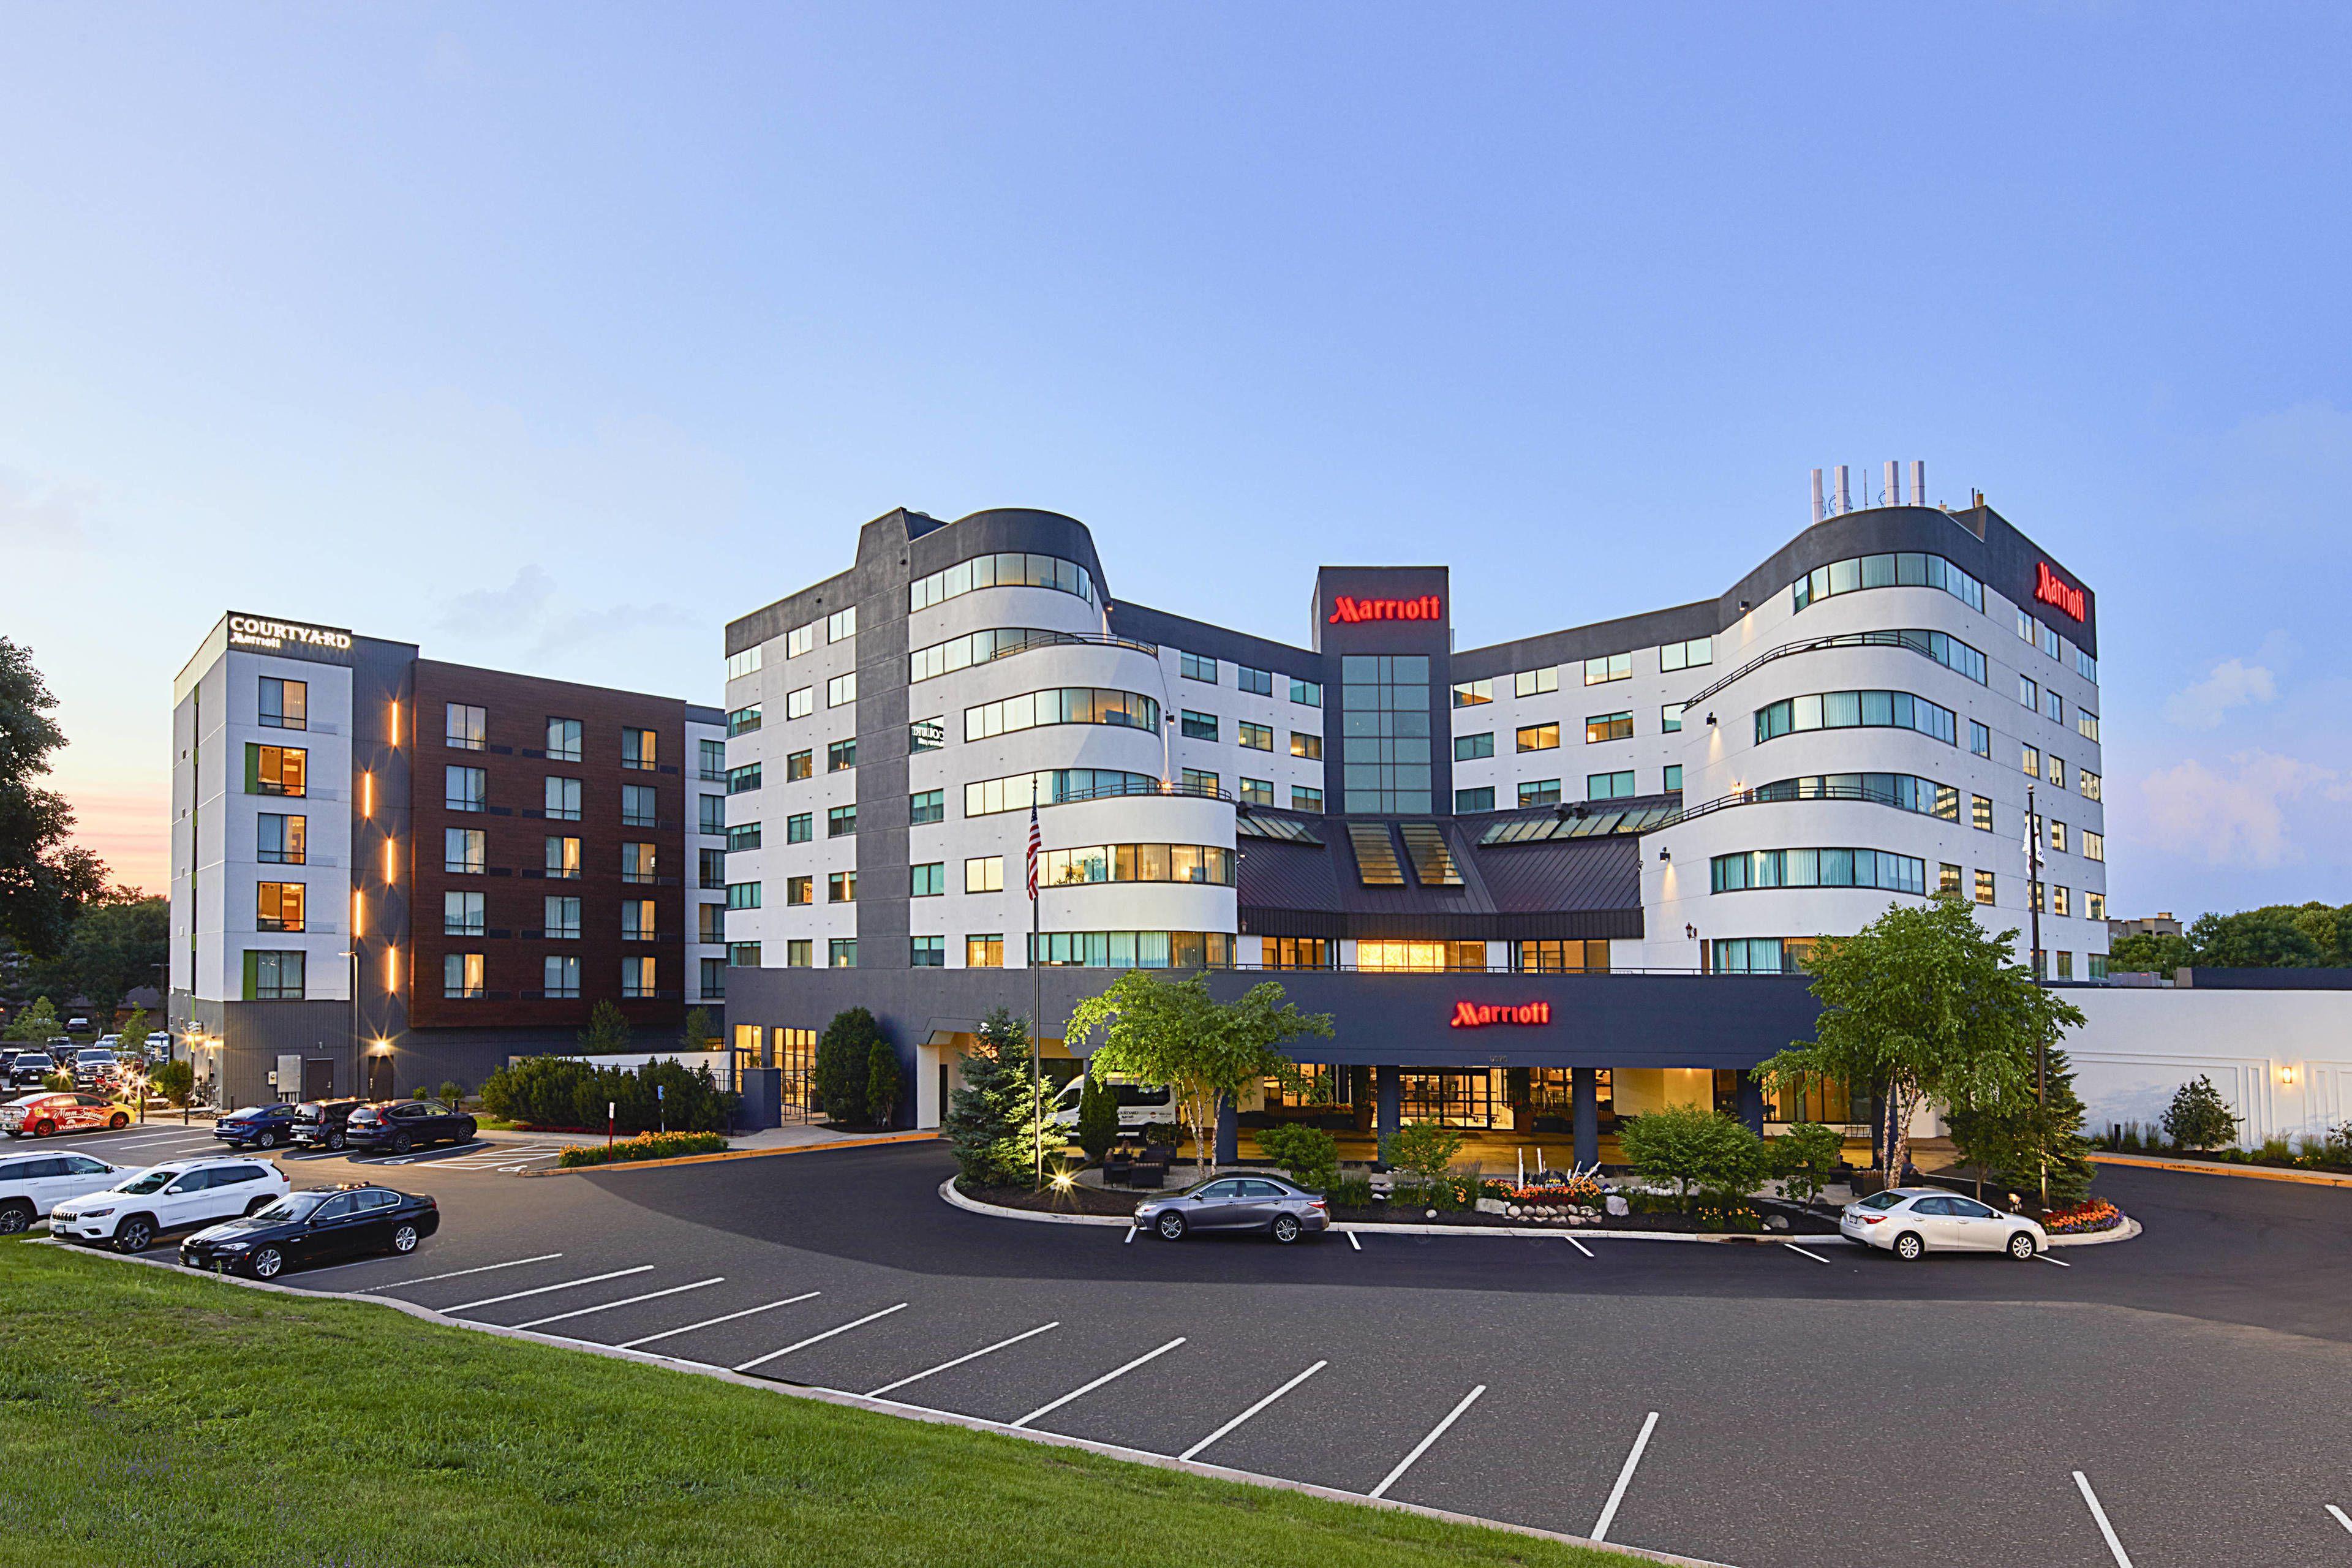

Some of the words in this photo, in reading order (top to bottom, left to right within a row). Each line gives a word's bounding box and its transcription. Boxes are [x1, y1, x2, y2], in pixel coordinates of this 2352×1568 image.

[2035, 562, 2085, 622] Marriott
[1329, 595, 1440, 624] Marriott
[230, 617, 350, 648] COURTYARD
[230, 632, 281, 648] Marriott
[1450, 1001, 1551, 1027] Marriott
